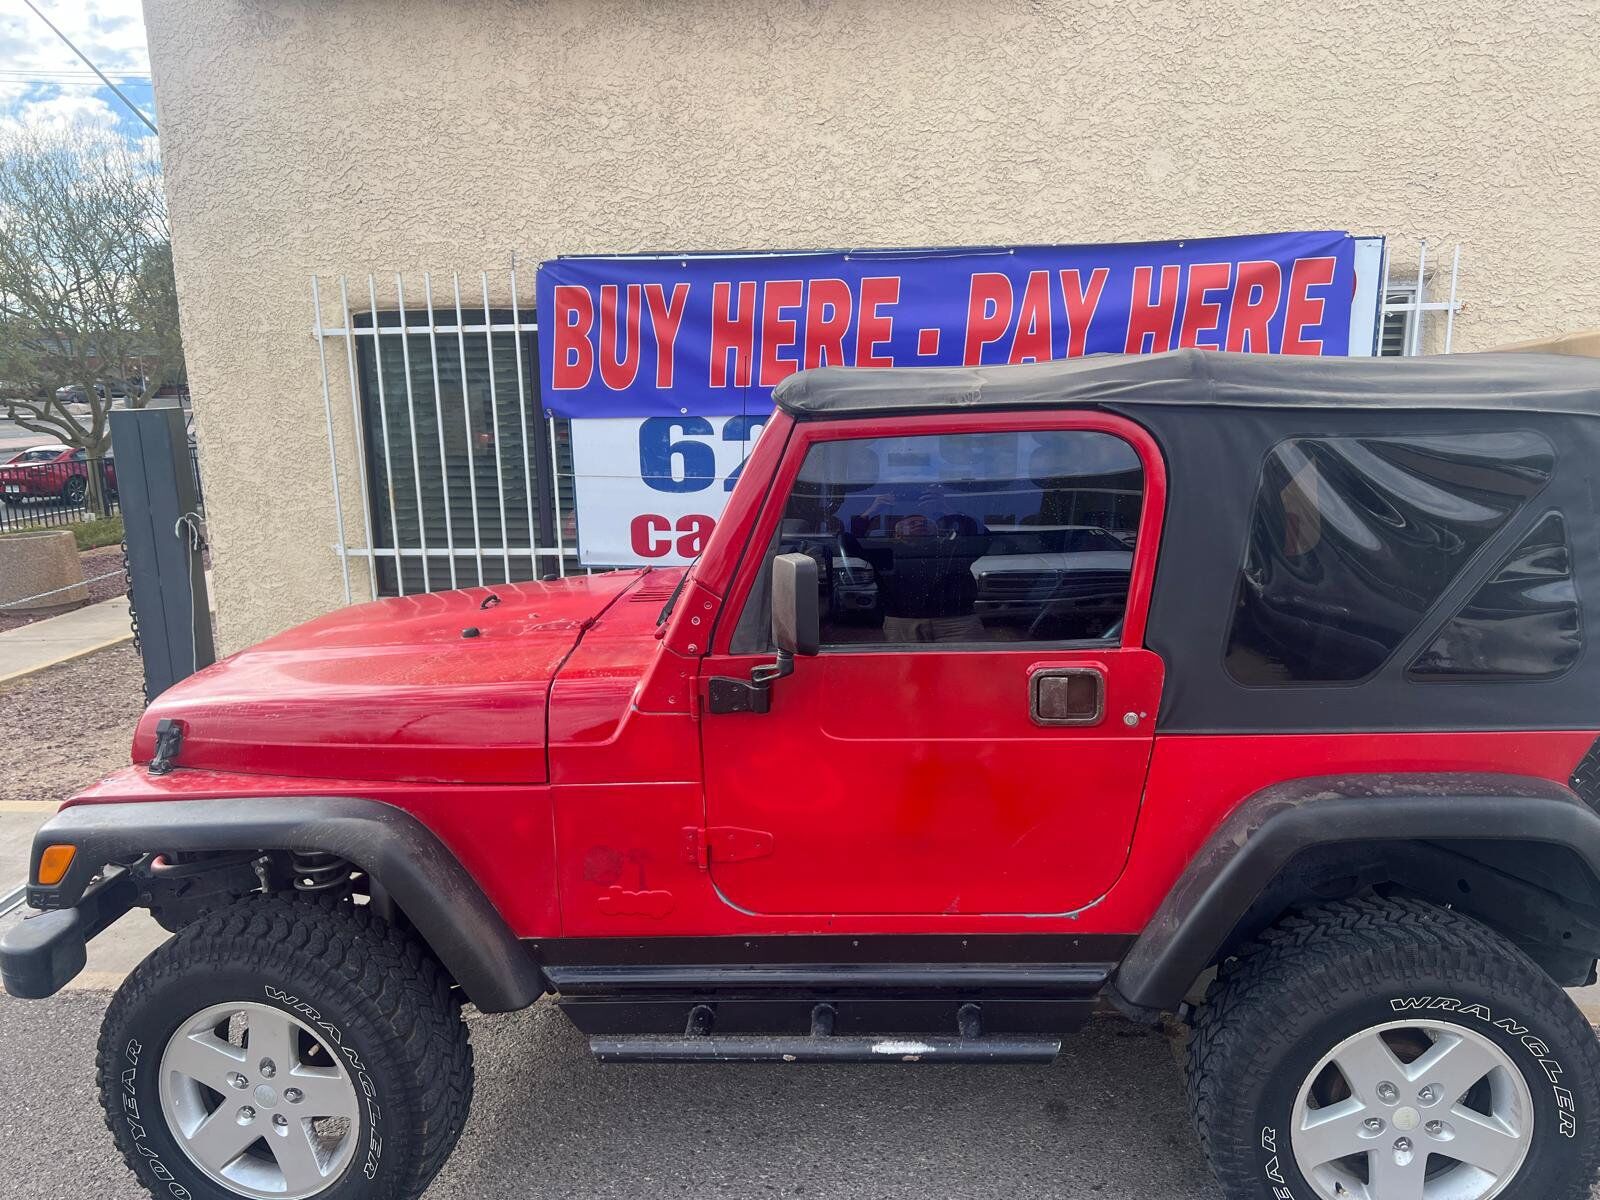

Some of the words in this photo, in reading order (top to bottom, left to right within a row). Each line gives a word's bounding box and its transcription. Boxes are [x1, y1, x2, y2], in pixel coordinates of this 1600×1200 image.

[552, 283, 691, 391] BUY
[709, 276, 901, 388] HERE
[963, 266, 1110, 366] PAY
[1124, 256, 1337, 356] HERE
[264, 985, 384, 1180] WRANGLER
[1390, 996, 1577, 1138] WRANGLER
